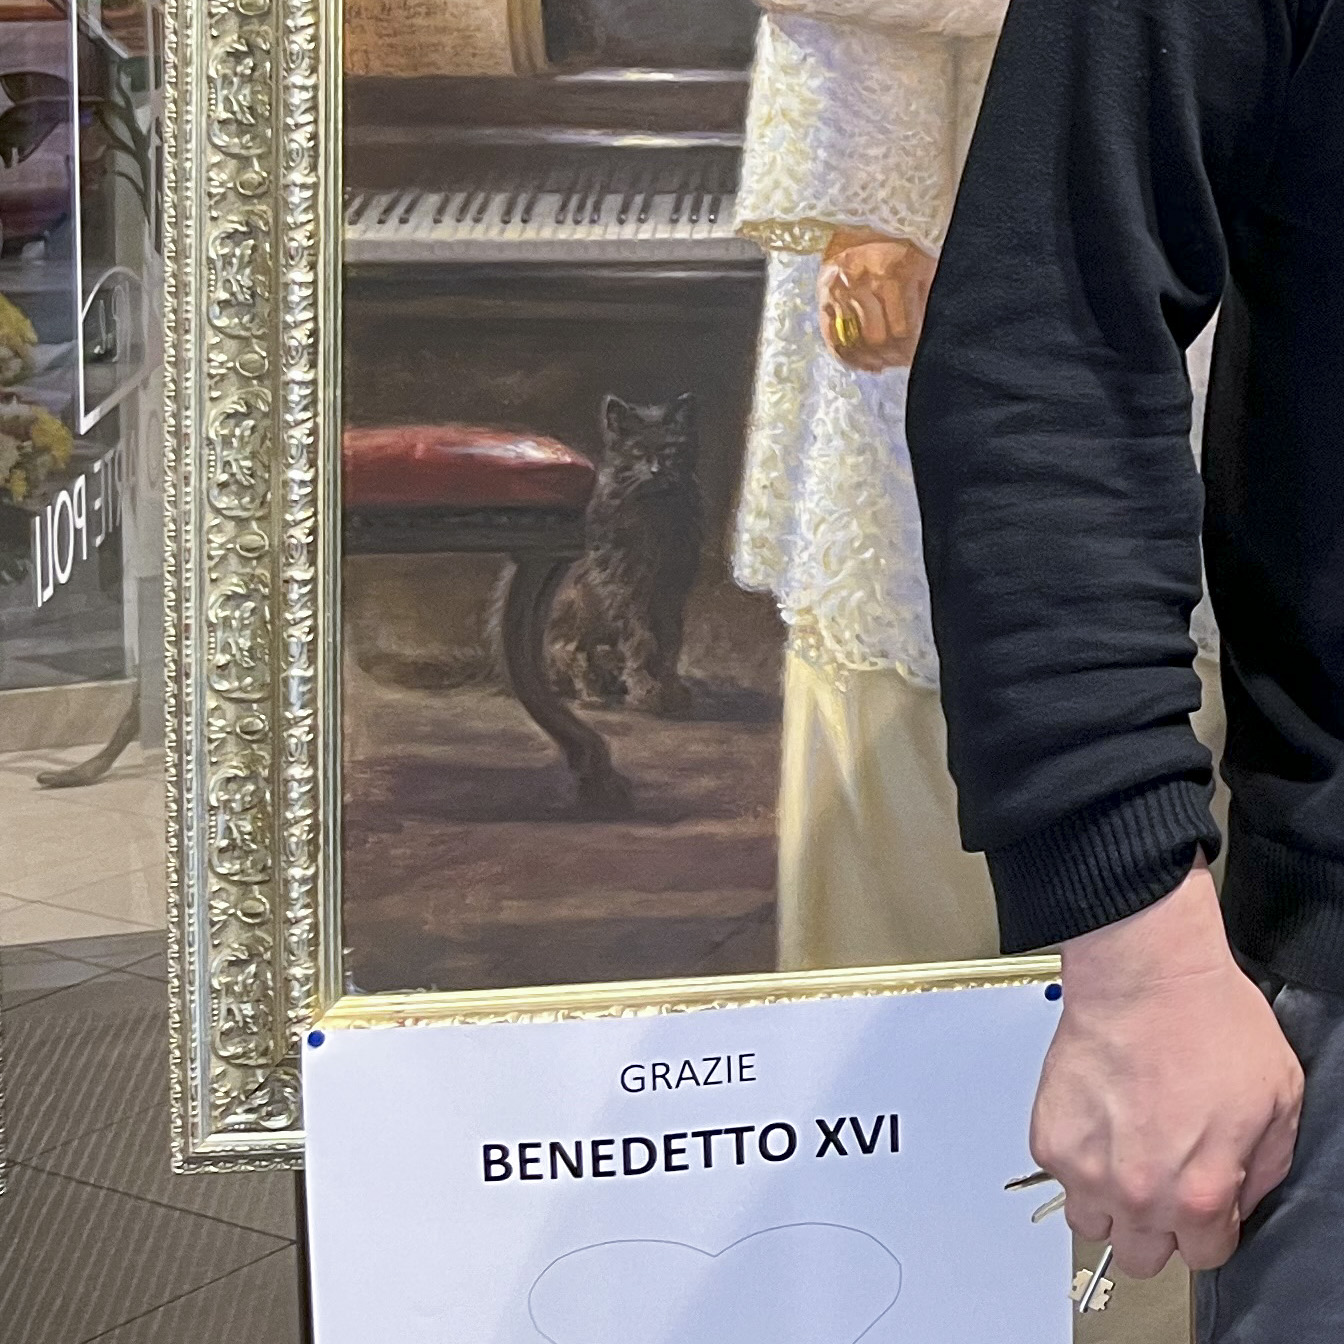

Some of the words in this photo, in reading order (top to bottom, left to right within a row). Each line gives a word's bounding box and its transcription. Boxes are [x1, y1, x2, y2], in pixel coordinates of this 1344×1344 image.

[620, 1052, 757, 1094] GRAZIE
[481, 1120, 797, 1183] BENEDETTO
[815, 1113, 902, 1159] XVI
